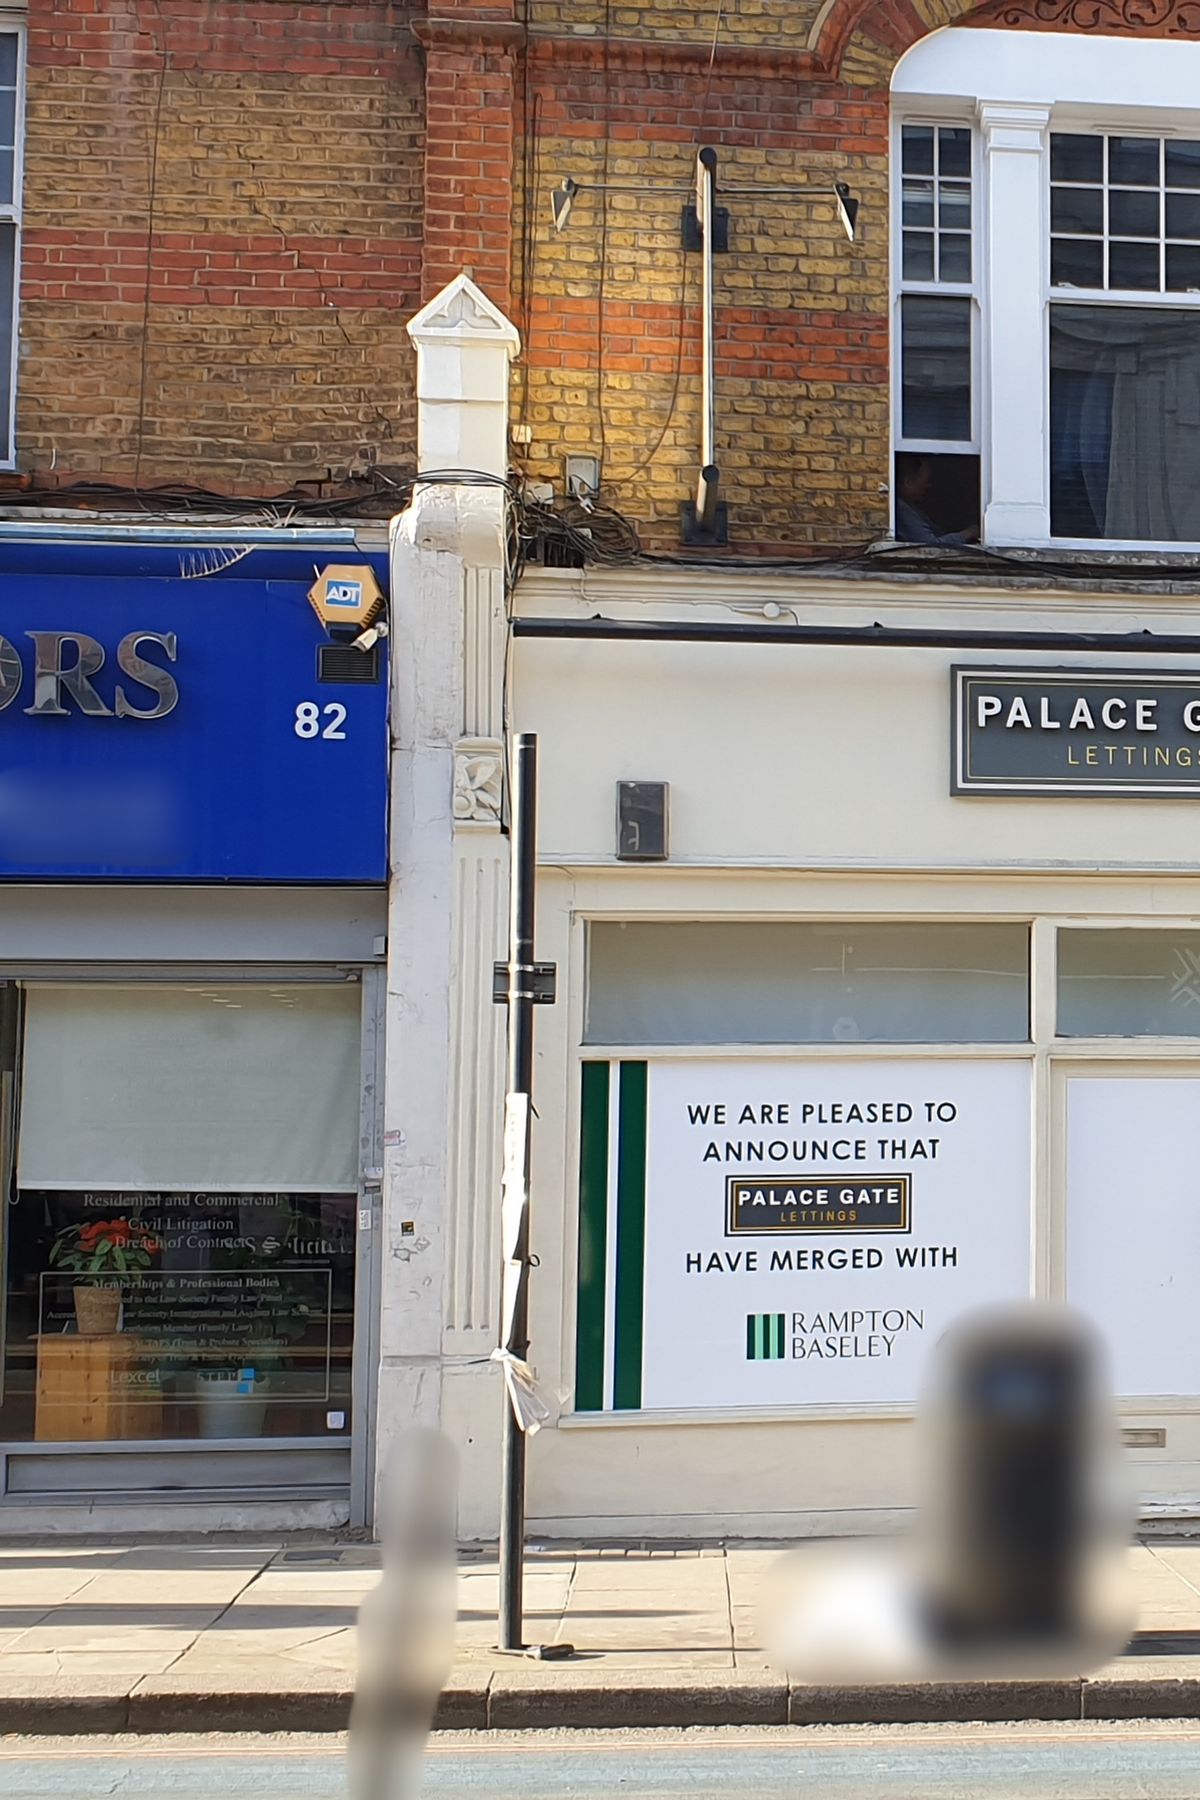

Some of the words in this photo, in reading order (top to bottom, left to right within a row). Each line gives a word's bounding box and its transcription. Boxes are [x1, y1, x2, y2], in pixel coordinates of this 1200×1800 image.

[326, 585, 361, 602] ADT
[294, 702, 347, 739] 82
[977, 696, 1158, 731] PALACE
[687, 1104, 726, 1125] WE
[738, 1104, 789, 1125] ARE
[802, 1102, 913, 1124] PLEASED
[924, 1102, 957, 1123] TO
[702, 1140, 866, 1163] ANNOUNCE
[878, 1138, 940, 1160] THAT
[165, 1194, 190, 1206] and
[194, 1193, 279, 1207] Commercial
[738, 1190, 829, 1207] PALACE
[839, 1188, 899, 1205] GATE
[128, 1217, 162, 1231] Civil
[166, 1217, 234, 1233] Litigation
[780, 1210, 858, 1223] LETTINGS
[115, 1236, 164, 1249] Breach
[167, 1235, 182, 1249] of
[686, 1251, 757, 1273] HAVE
[769, 1248, 883, 1271] MERGED
[896, 1246, 958, 1268] WITH
[166, 1278, 176, 1289] &
[179, 1277, 243, 1289] Professional
[246, 1277, 280, 1288] Bodies
[792, 1310, 924, 1334] RAMPTON
[792, 1334, 896, 1359] BASELEY
[111, 1369, 160, 1384] Lexcel
